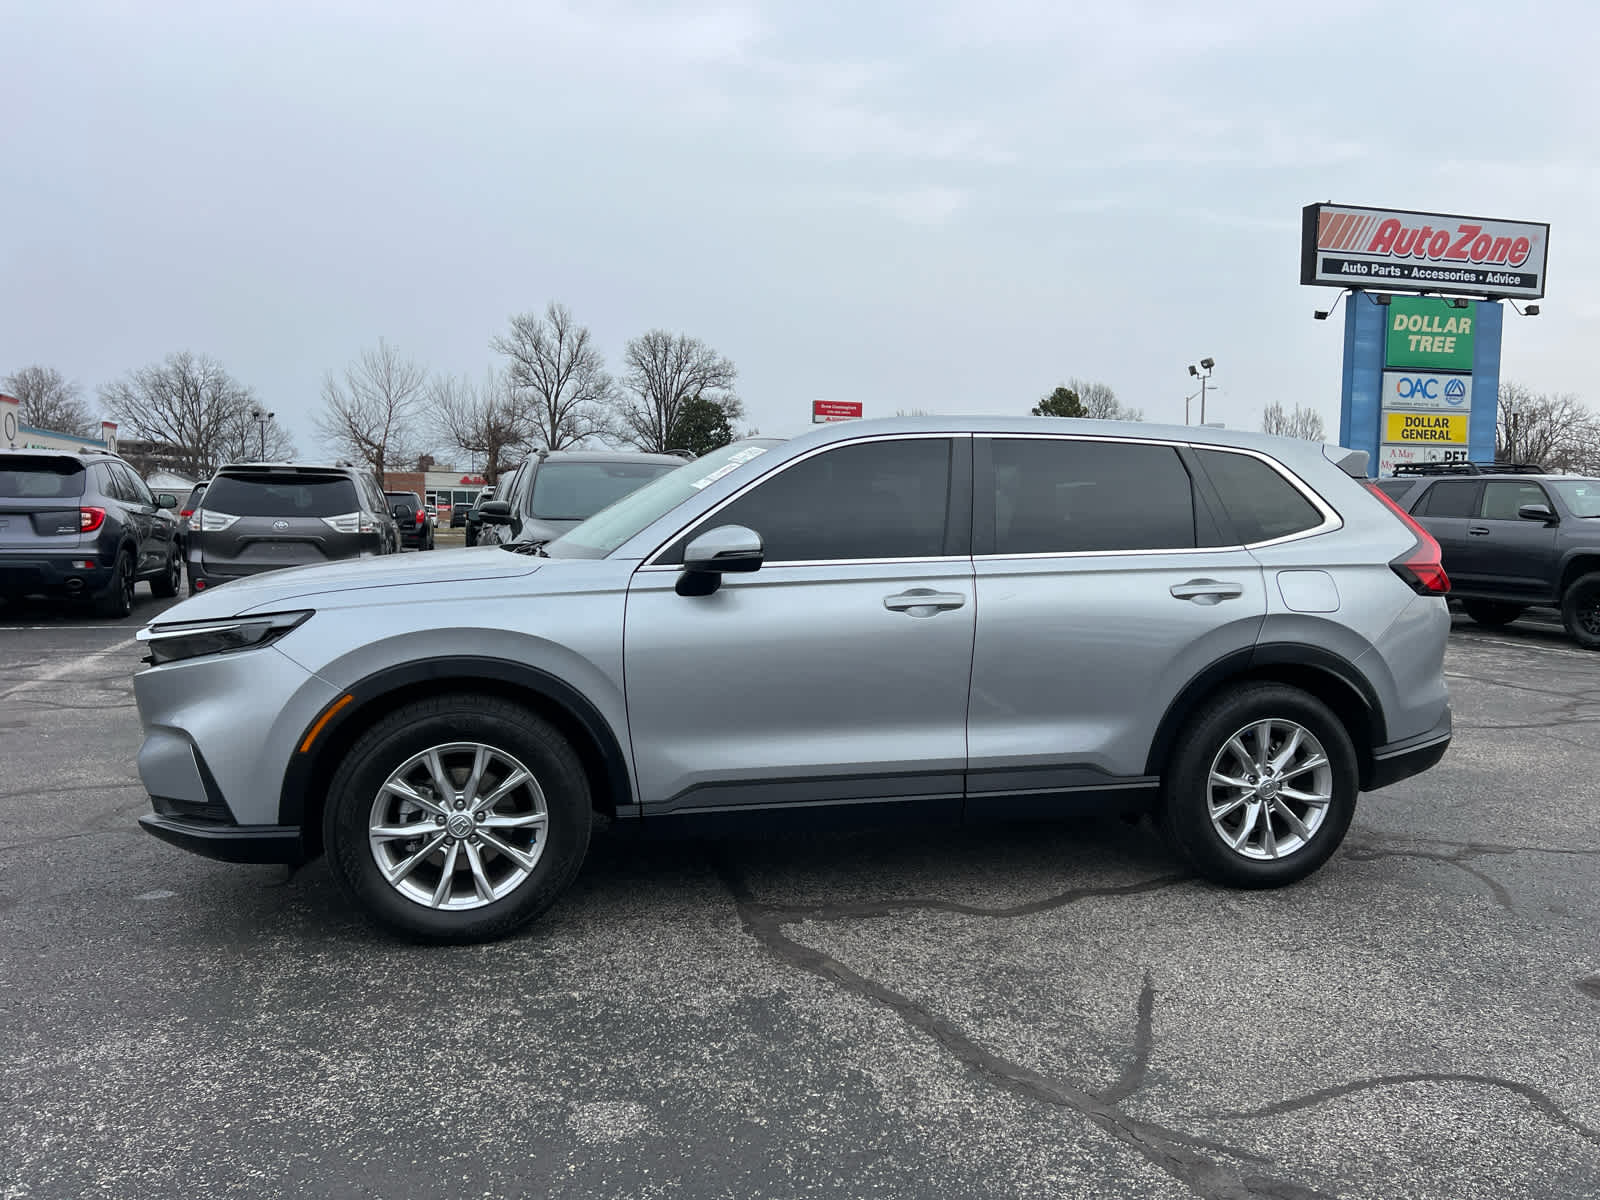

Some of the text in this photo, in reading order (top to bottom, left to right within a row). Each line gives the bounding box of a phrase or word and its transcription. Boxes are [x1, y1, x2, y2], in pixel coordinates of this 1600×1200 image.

[1367, 218, 1531, 267] AutoZone
[1341, 261, 1521, 285] Auto Parts Accessories Advice
[1393, 314, 1472, 334] DOLLAR
[1408, 335, 1457, 353] TREE
[1396, 377, 1439, 399] OAC
[1405, 416, 1449, 428] DOLLAR
[1401, 428, 1452, 440] GENERAL
